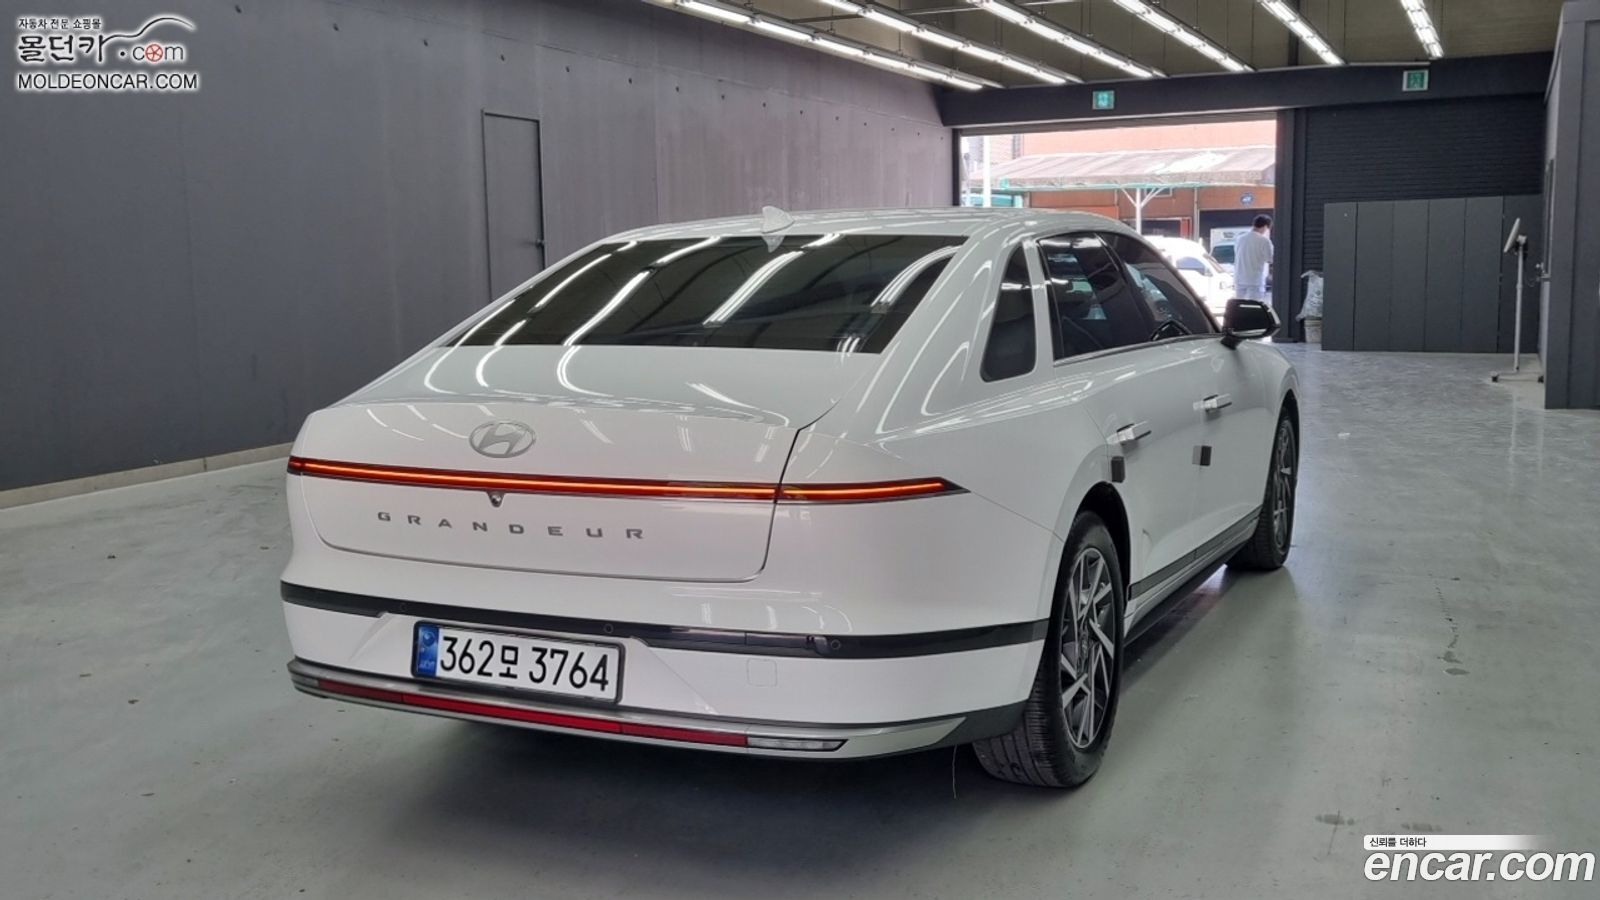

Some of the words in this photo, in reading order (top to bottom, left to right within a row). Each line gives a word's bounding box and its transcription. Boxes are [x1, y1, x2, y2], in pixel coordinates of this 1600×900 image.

[377, 511, 643, 539] GRANDEUR
[440, 635, 519, 679] 362모
[528, 646, 609, 692] 3764
